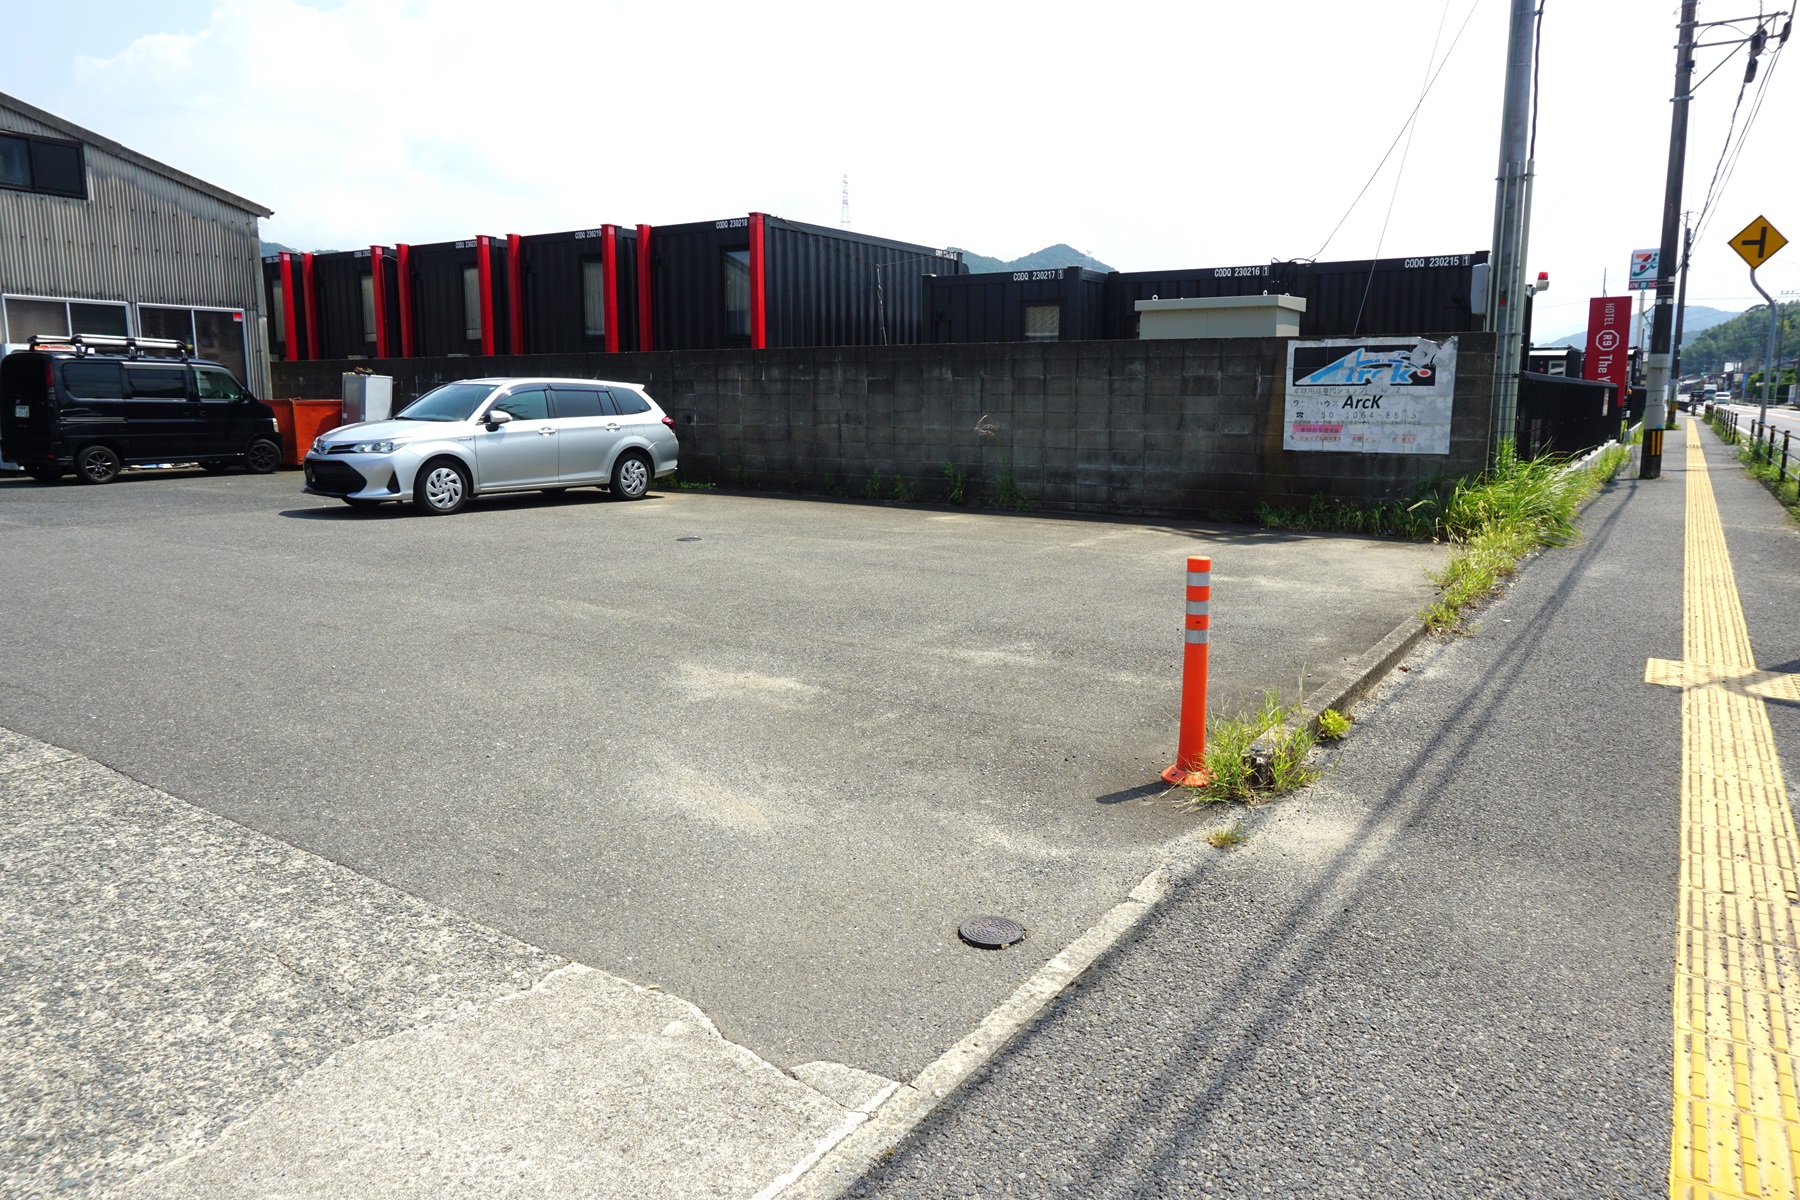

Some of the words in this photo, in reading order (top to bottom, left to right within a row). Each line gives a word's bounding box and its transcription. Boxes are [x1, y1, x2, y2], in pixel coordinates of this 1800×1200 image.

[715, 220, 728, 229] CODQ
[1404, 258, 1425, 268] CODQ
[1429, 256, 1459, 267] 230215
[1013, 272, 1028, 281] CODQ
[1032, 270, 1055, 280] 230217
[1214, 268, 1231, 277] CODQ
[1234, 267, 1260, 277] 230216
[1604, 303, 1615, 326] HOTEL
[1602, 334, 1613, 346] R9
[1598, 354, 1613, 374] The
[1341, 394, 1383, 409] ArcK
